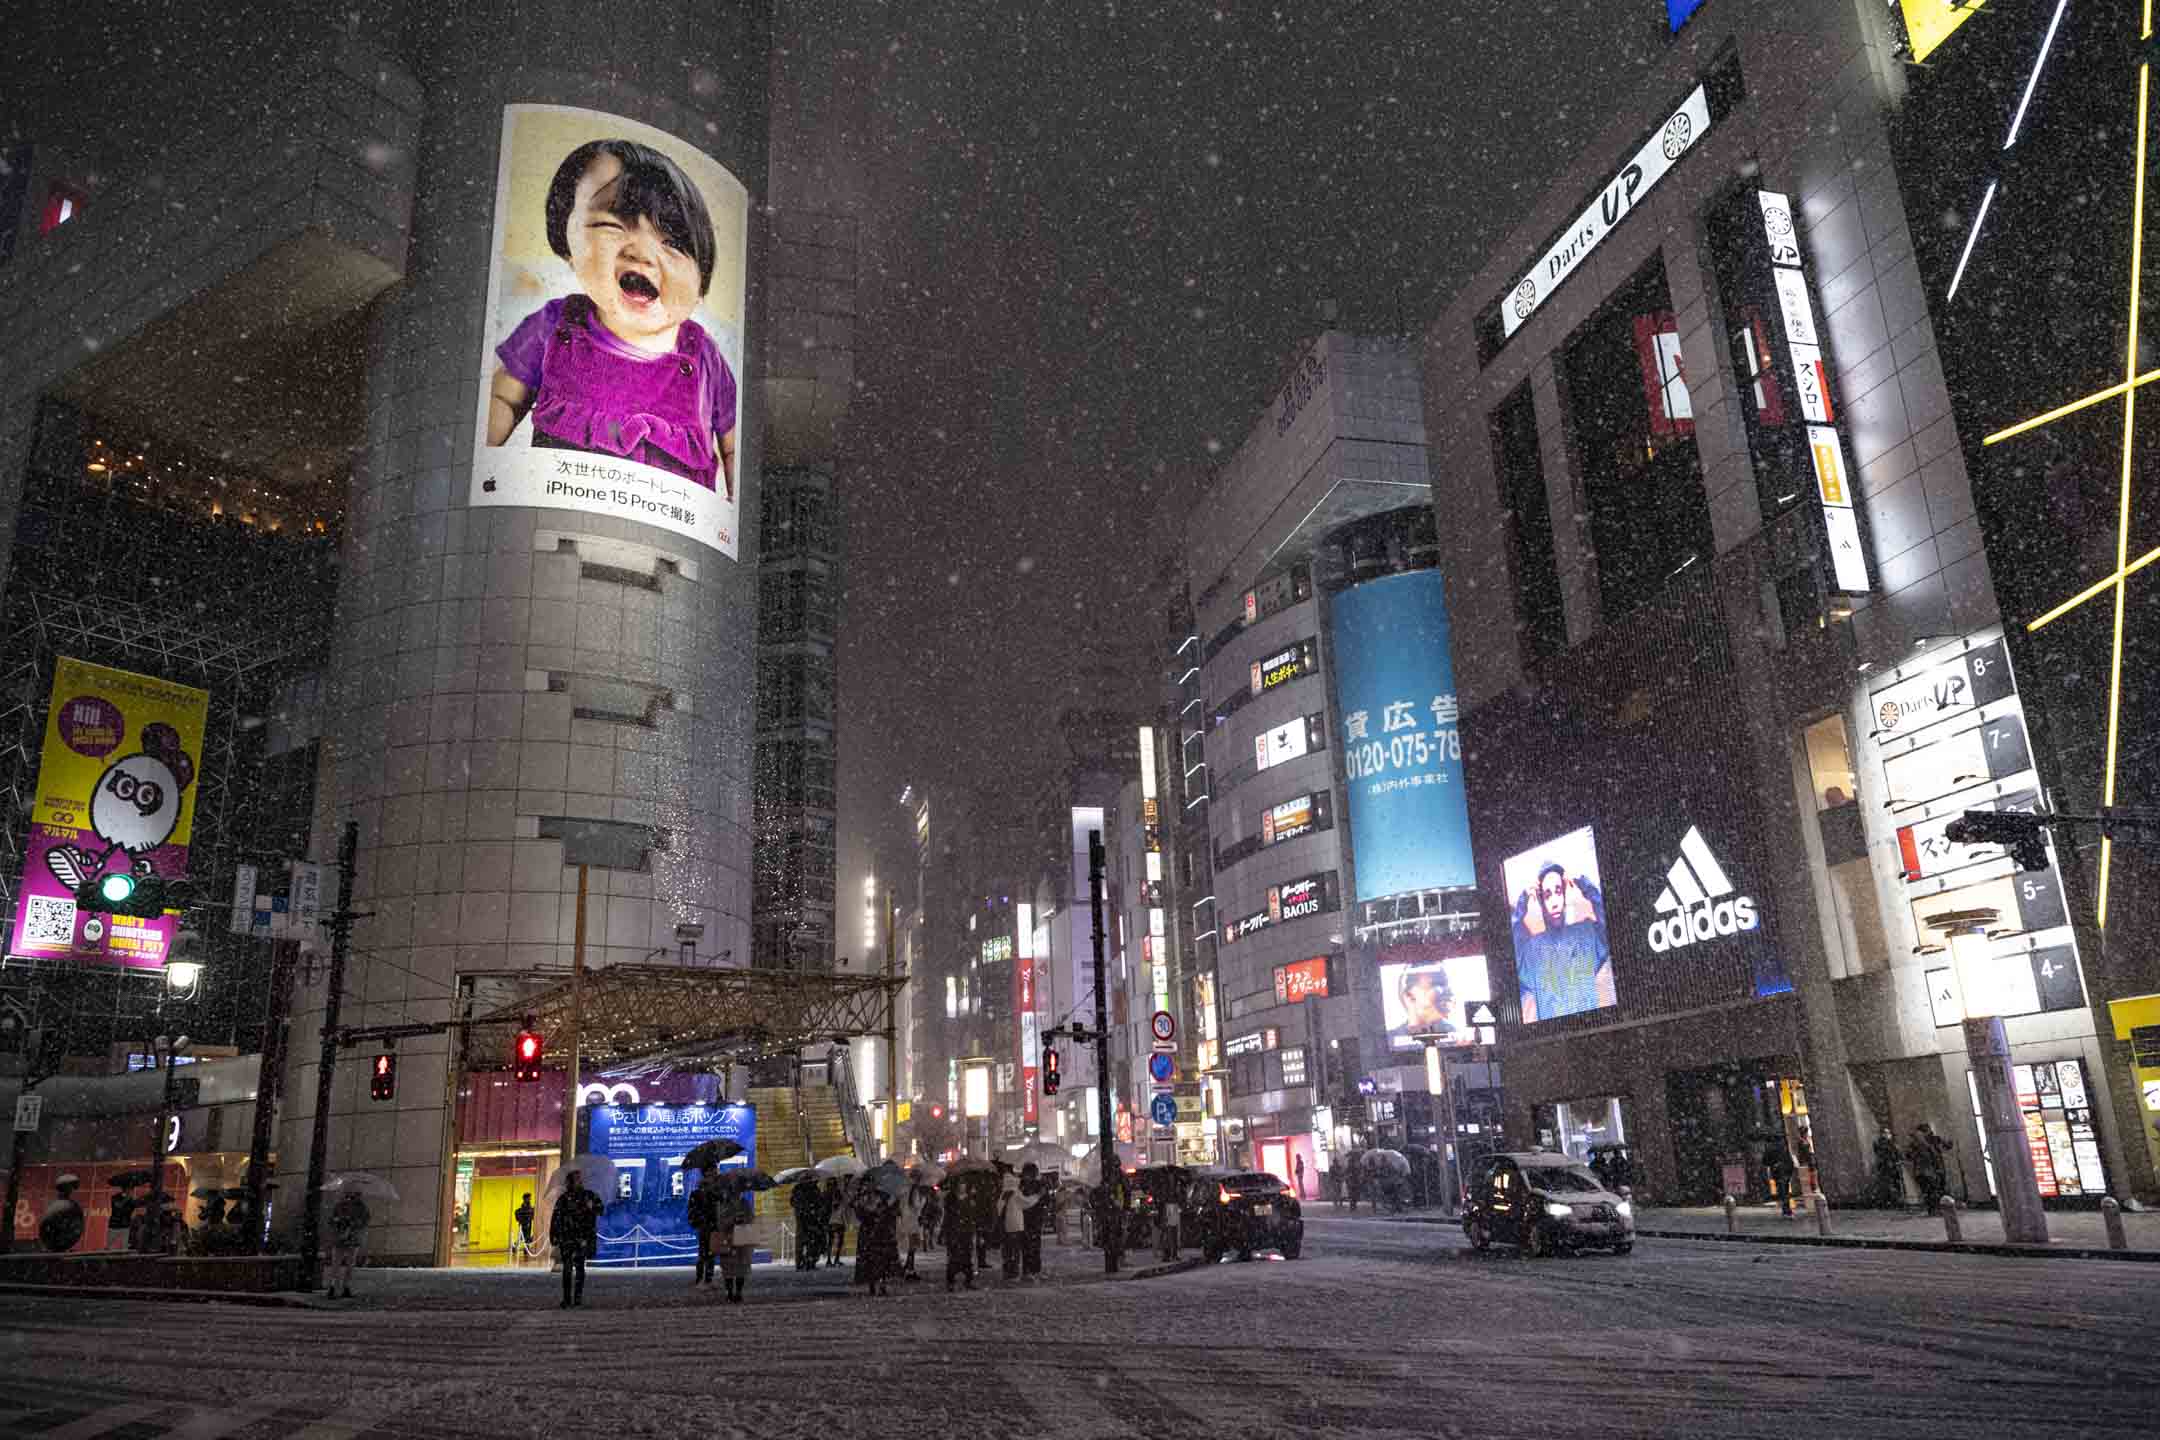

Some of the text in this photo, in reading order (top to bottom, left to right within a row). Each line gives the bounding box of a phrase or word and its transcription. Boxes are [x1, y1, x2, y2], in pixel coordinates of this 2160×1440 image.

[1549, 164, 1642, 281] Darts UP
[1799, 362, 1819, 418] スシロー
[546, 480, 607, 501] iPhone
[610, 490, 628, 505] 15
[558, 460, 691, 502] 次世代のポートレート
[1933, 675, 1966, 706] UP
[1648, 896, 1759, 953] adidas
[1157, 1018, 1170, 1033] 30
